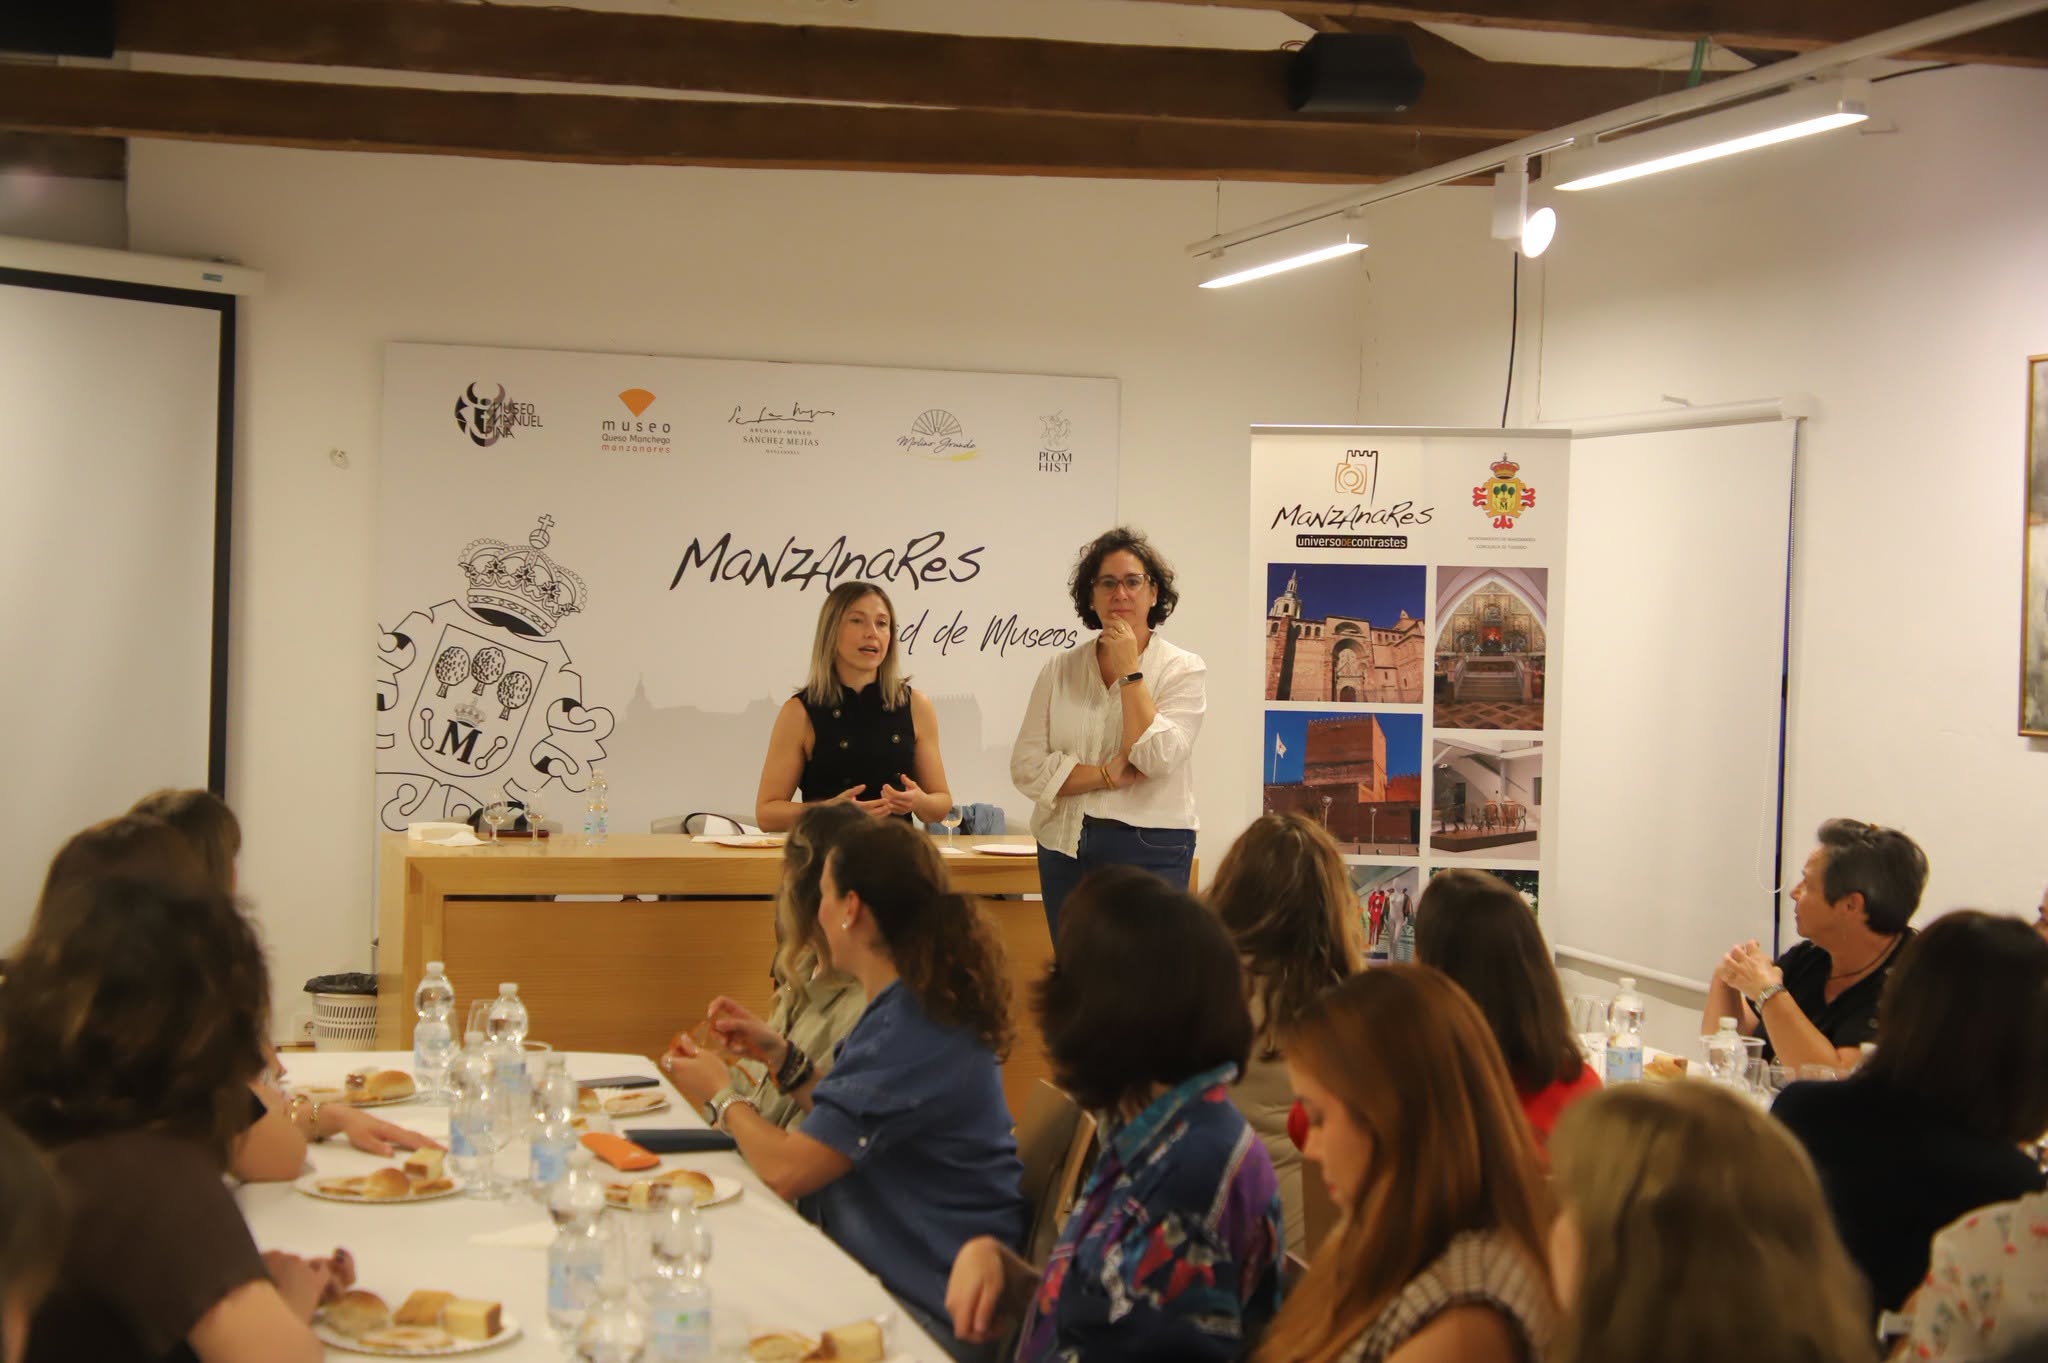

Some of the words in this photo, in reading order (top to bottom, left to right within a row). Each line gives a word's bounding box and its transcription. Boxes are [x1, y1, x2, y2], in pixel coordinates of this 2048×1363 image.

[602, 420, 671, 433] museo
[601, 433, 627, 442] Queso
[630, 434, 671, 445] Manchego
[601, 444, 671, 454] manzanares
[1039, 451, 1072, 463] PLOM
[1039, 462, 1072, 473] HIST
[933, 610, 968, 656] de
[980, 614, 1078, 657] Museos
